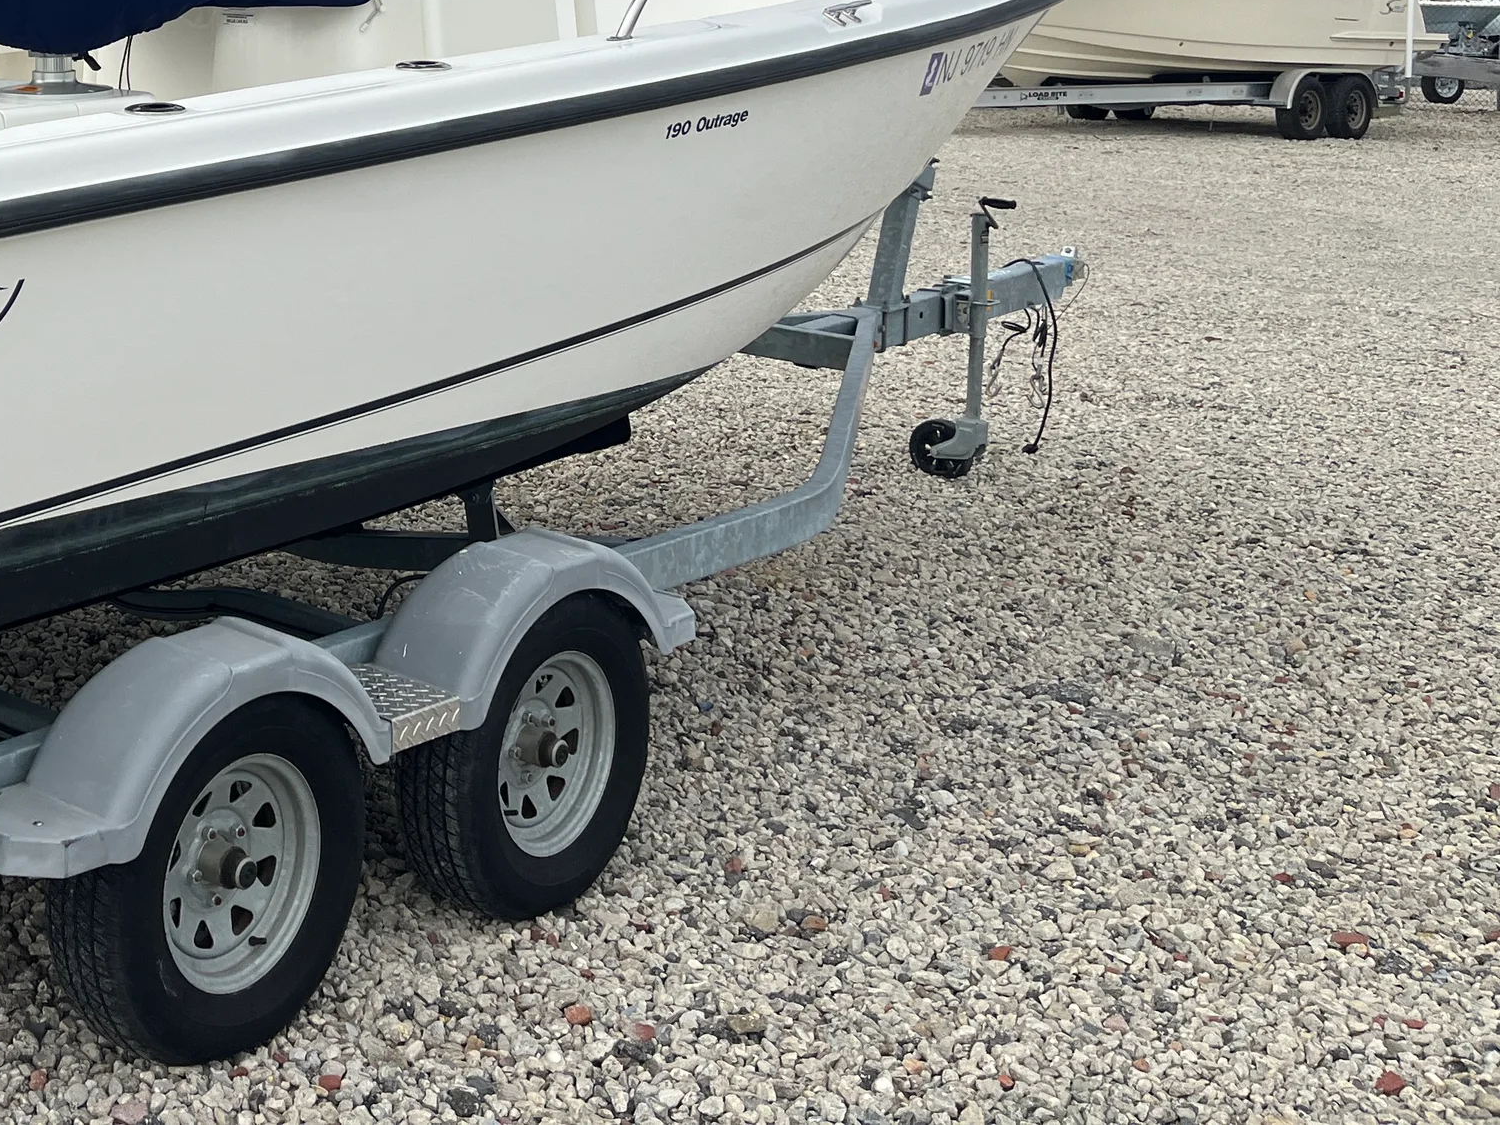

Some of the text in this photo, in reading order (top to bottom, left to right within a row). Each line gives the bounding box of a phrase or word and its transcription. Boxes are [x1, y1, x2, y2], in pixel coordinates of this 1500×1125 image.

[936, 49, 963, 87] NJ
[960, 36, 998, 76] 9719
[665, 110, 749, 140] 190 Outrage
